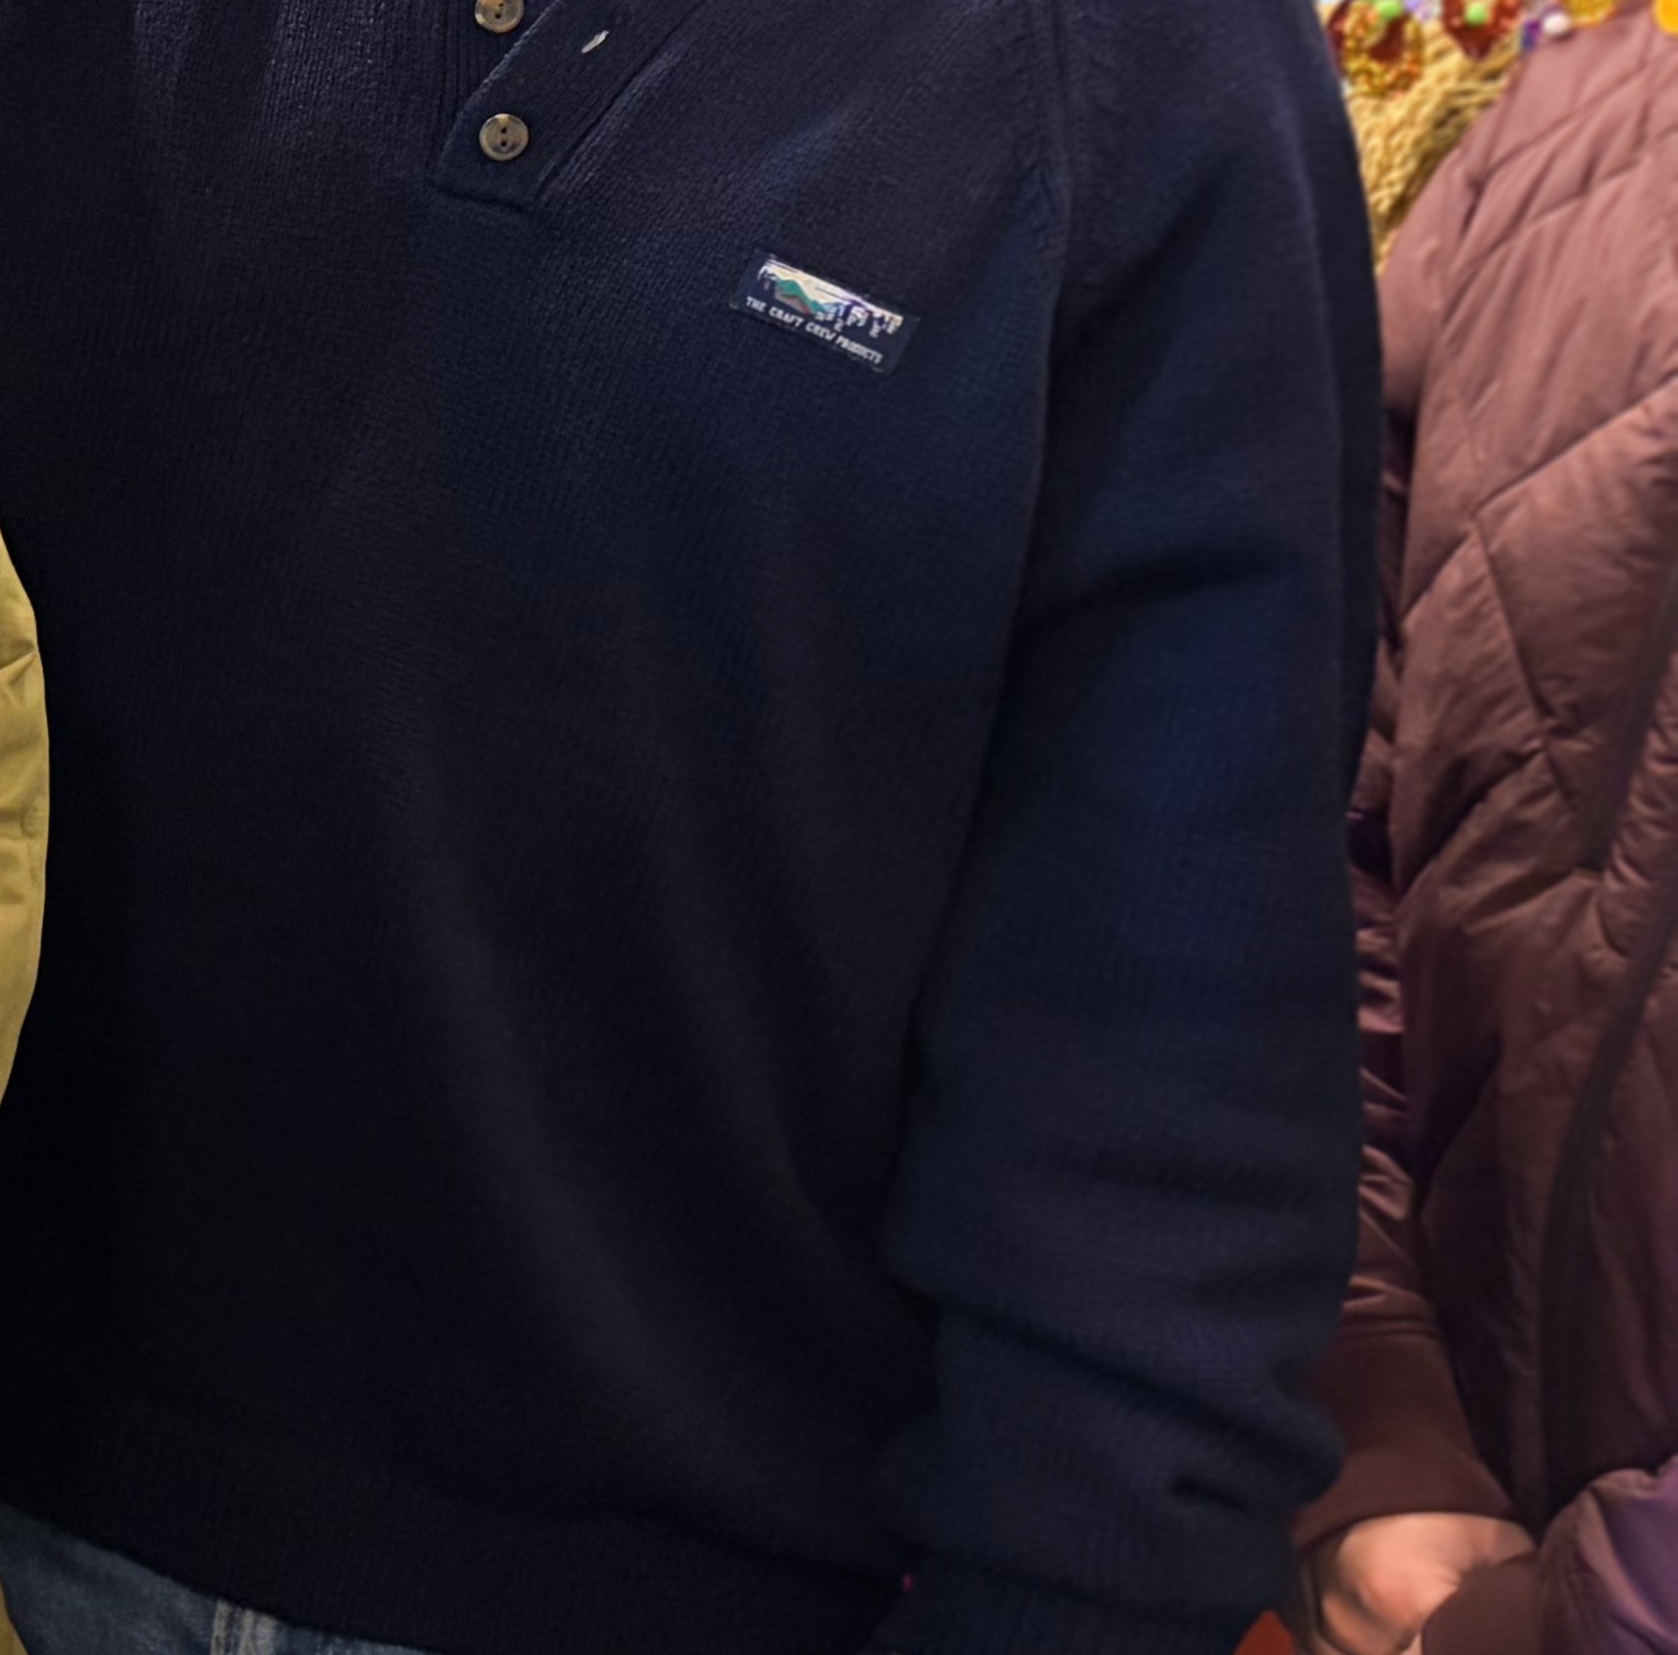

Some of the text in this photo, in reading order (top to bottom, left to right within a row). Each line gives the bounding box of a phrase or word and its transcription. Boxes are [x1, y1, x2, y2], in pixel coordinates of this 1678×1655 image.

[746, 296, 765, 312] THE
[769, 305, 804, 329] CRAFT
[805, 322, 836, 342] CREW
